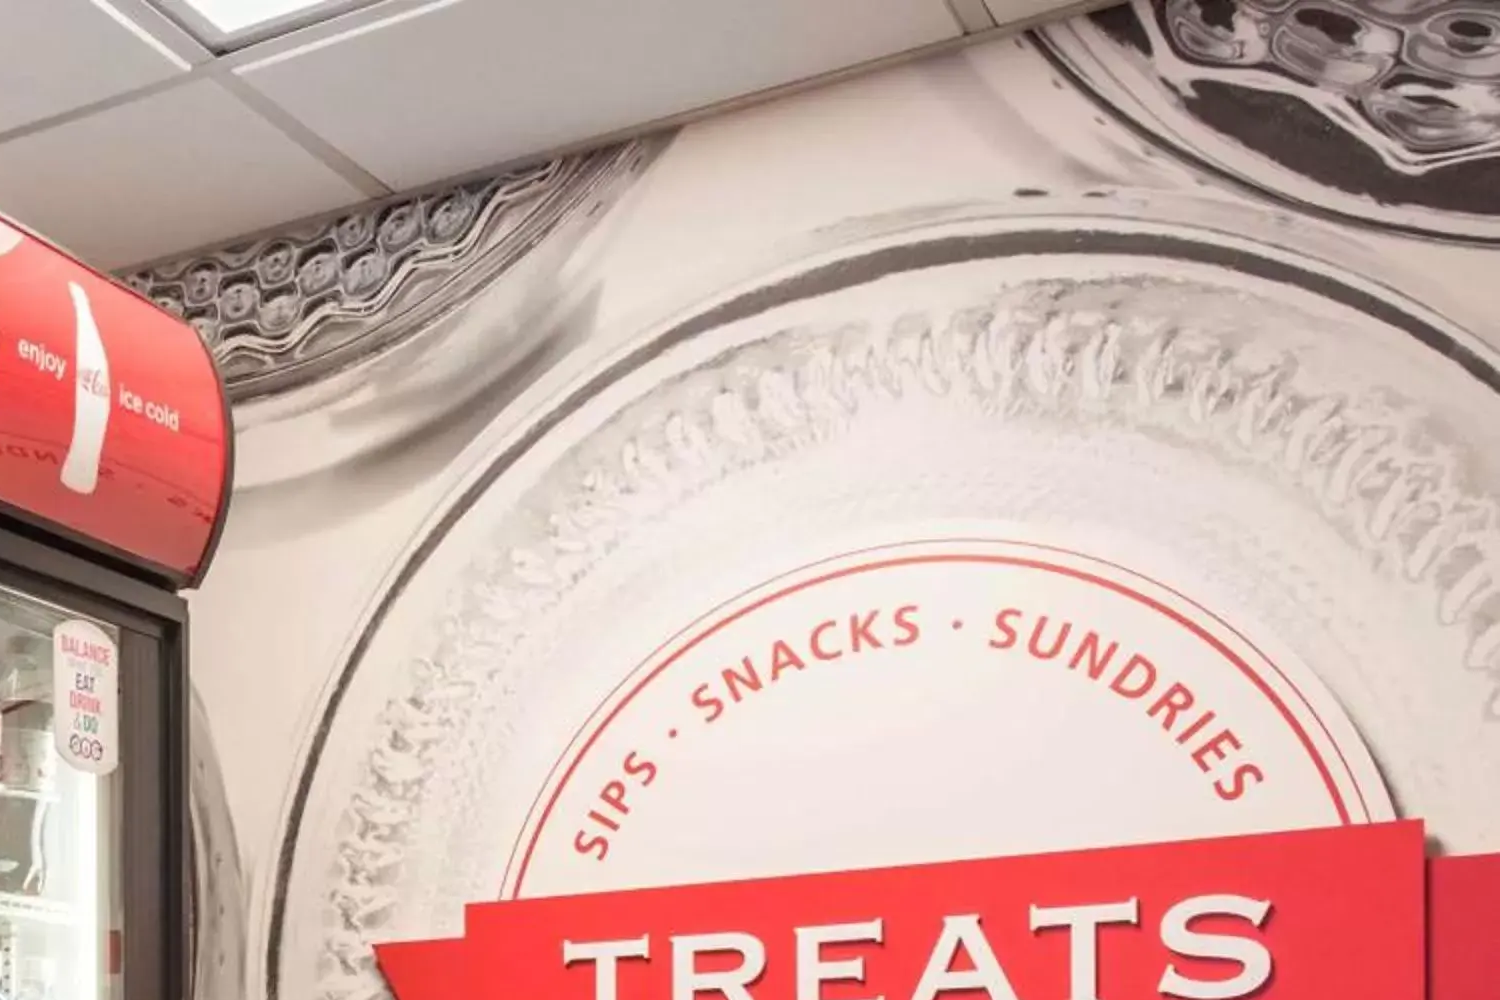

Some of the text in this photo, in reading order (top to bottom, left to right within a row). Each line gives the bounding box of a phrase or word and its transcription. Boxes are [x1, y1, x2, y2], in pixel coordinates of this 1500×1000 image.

[17, 338, 67, 381] enjoy
[118, 383, 180, 432] ice cold
[75, 672, 96, 693] EAT
[573, 605, 1268, 863] SIPS SNACKS SUNDRIES
